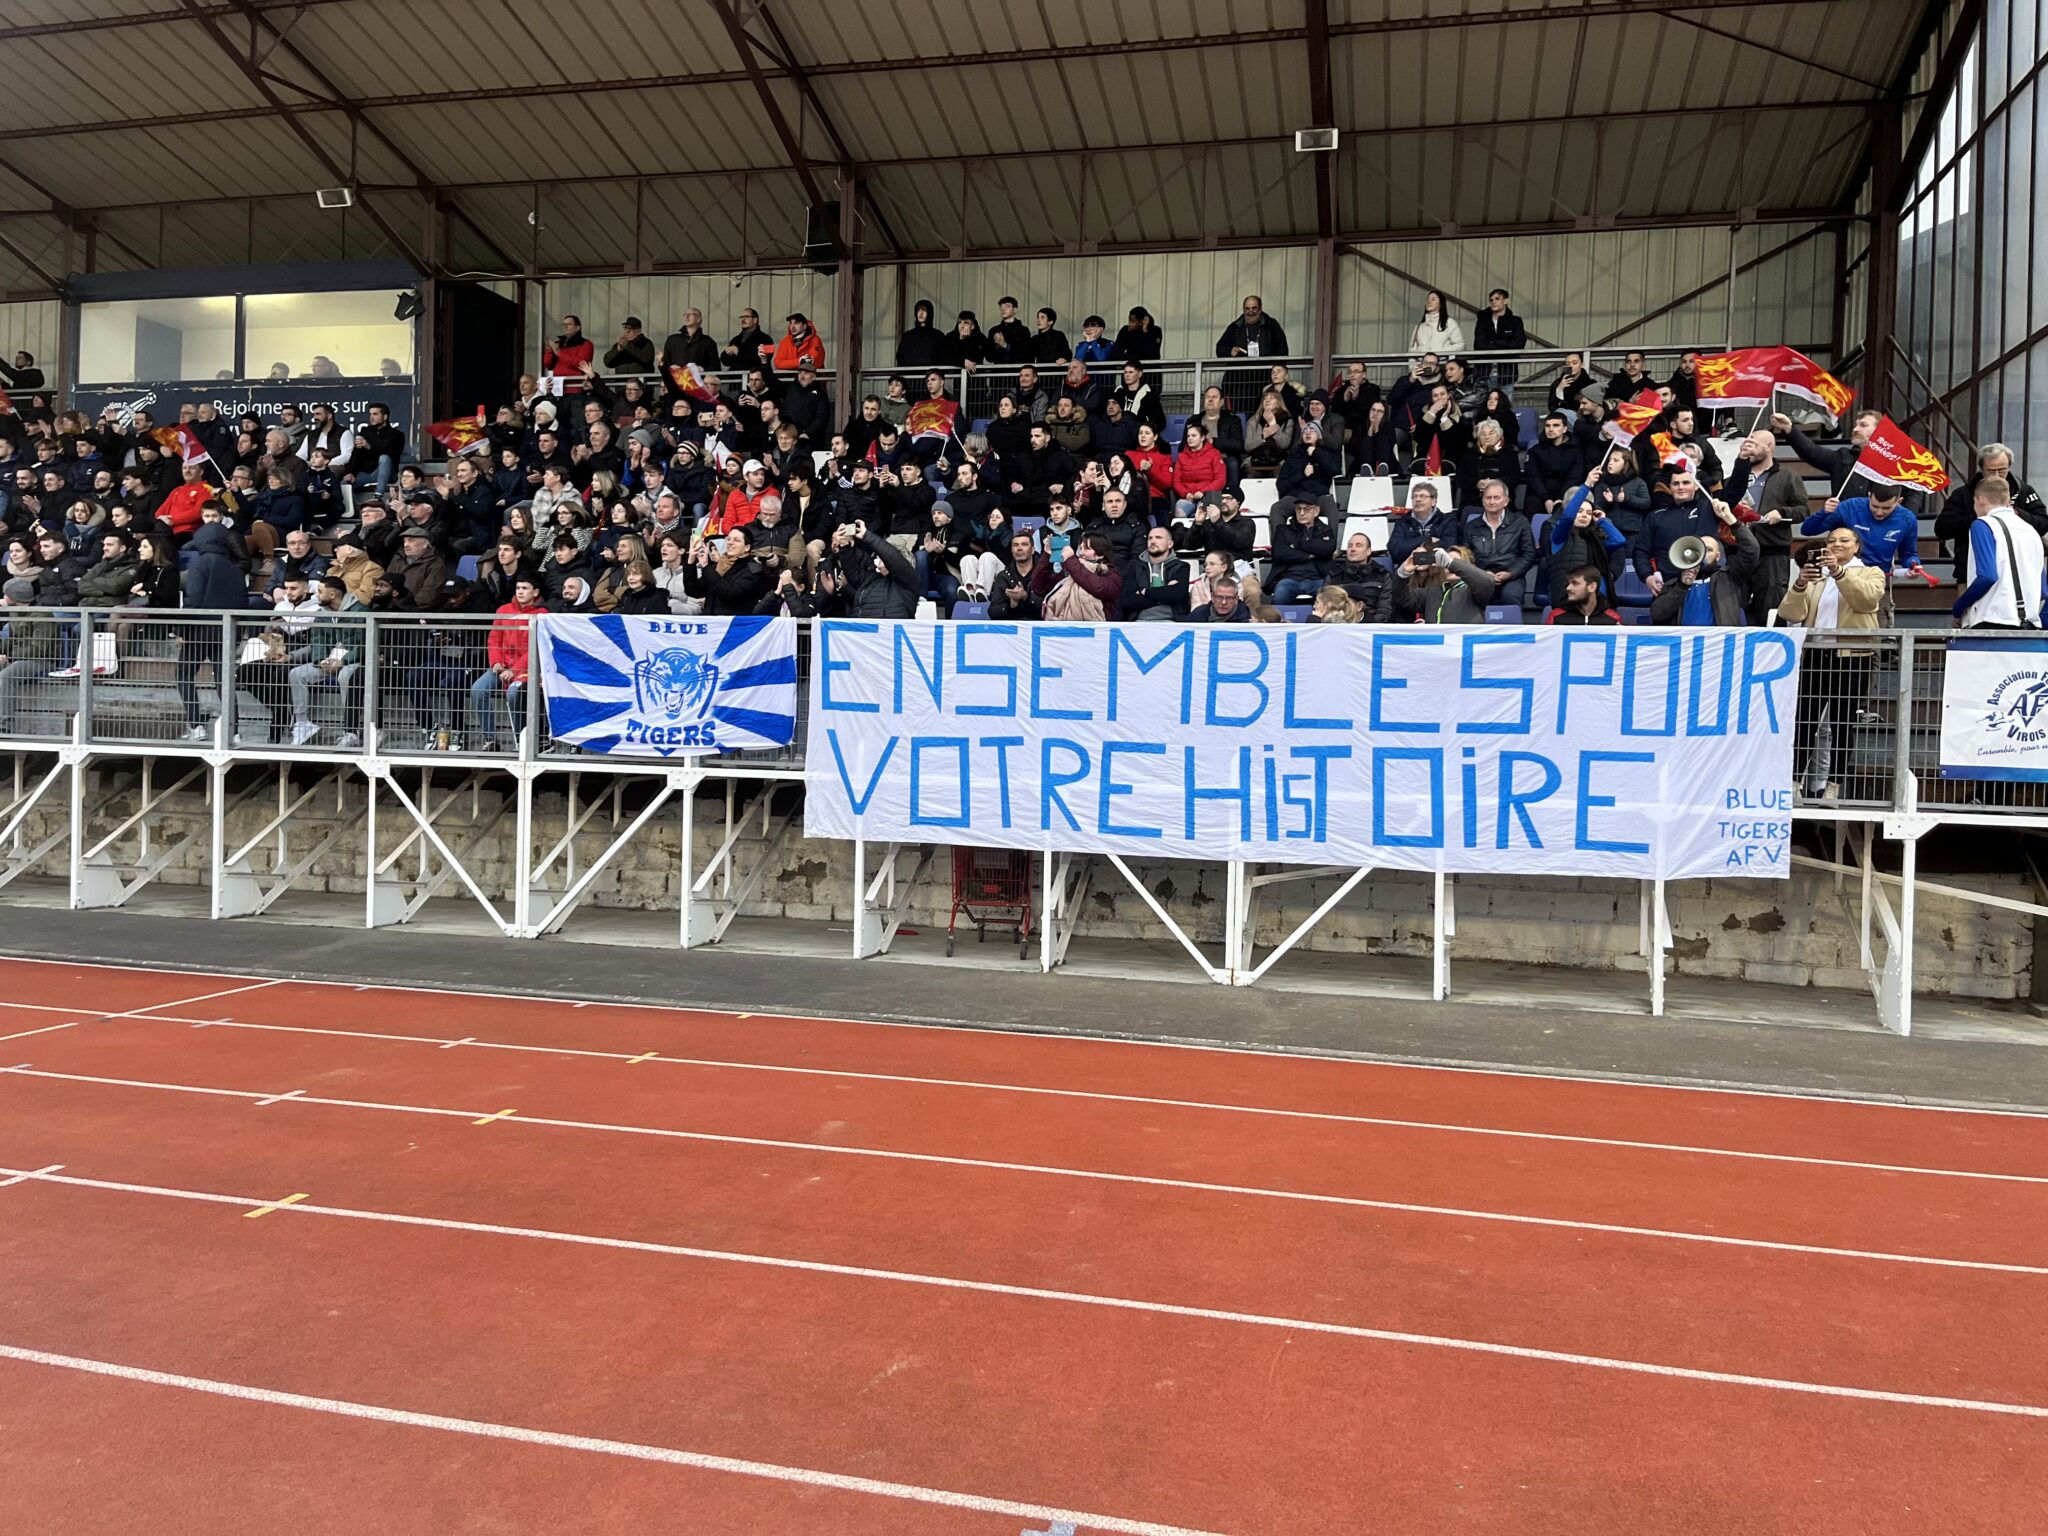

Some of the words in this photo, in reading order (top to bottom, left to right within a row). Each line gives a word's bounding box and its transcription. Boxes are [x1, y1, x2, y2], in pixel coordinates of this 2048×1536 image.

[342, 400, 369, 414] sur
[648, 621, 709, 635] BLUE
[1556, 631, 1795, 737] POUR
[1986, 670, 2038, 706] Association
[626, 718, 716, 746] TIGERS
[2007, 725, 2047, 742] VIROIS
[2020, 743, 2040, 754] pour
[826, 728, 1167, 838] VOTRE
[1726, 788, 1792, 811] BLUE
[1717, 821, 1790, 840] TIGERS
[1726, 844, 1783, 867] AFV
